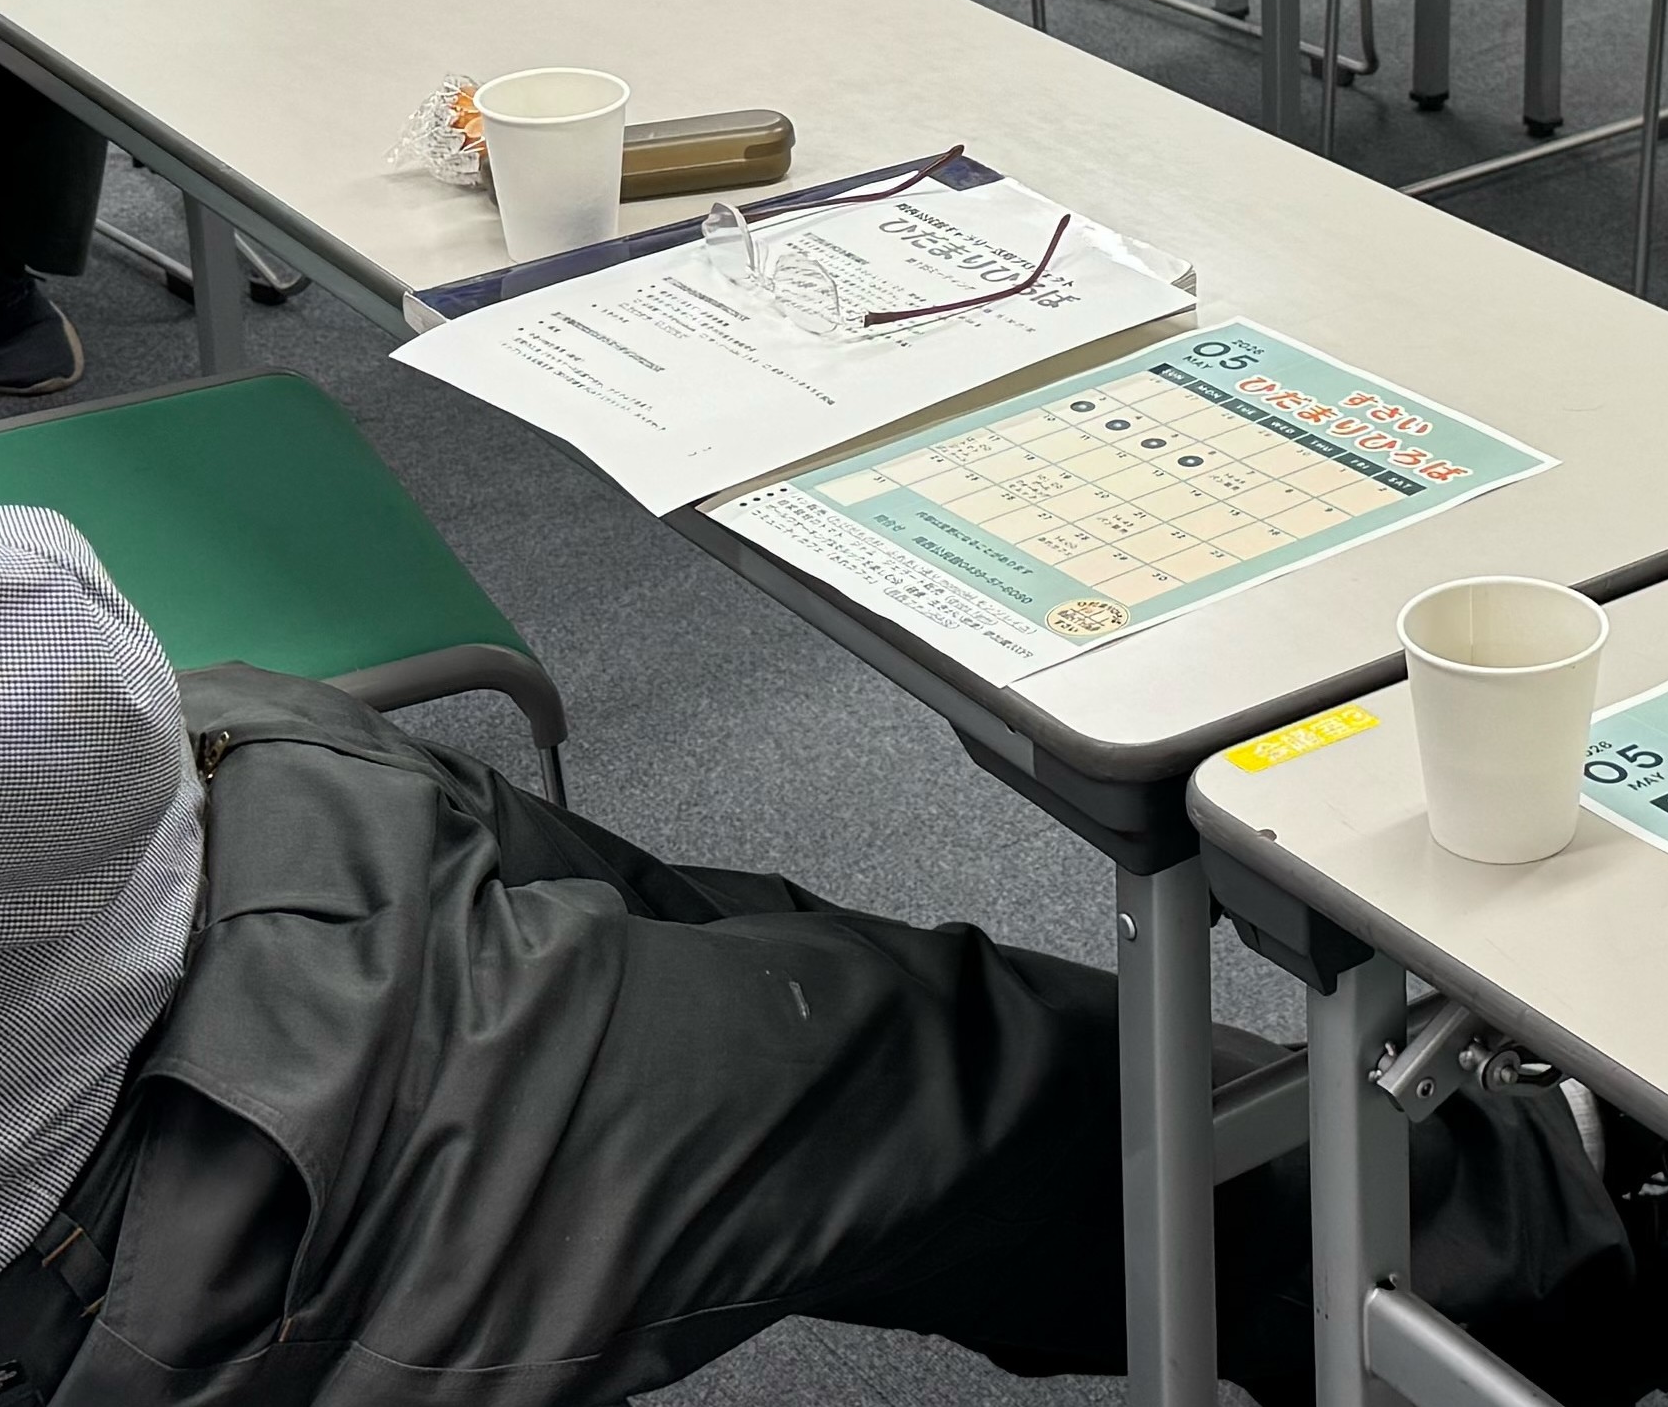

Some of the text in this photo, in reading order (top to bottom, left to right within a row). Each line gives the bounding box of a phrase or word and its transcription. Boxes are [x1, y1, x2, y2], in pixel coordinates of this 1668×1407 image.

[1182, 355, 1212, 368] MAY
[1192, 341, 1259, 369] 05
[1238, 377, 1468, 482] ひだまりひろば
[1348, 393, 1430, 434] すさい
[1583, 744, 1664, 784] 05
[1627, 771, 1664, 790] MAY
